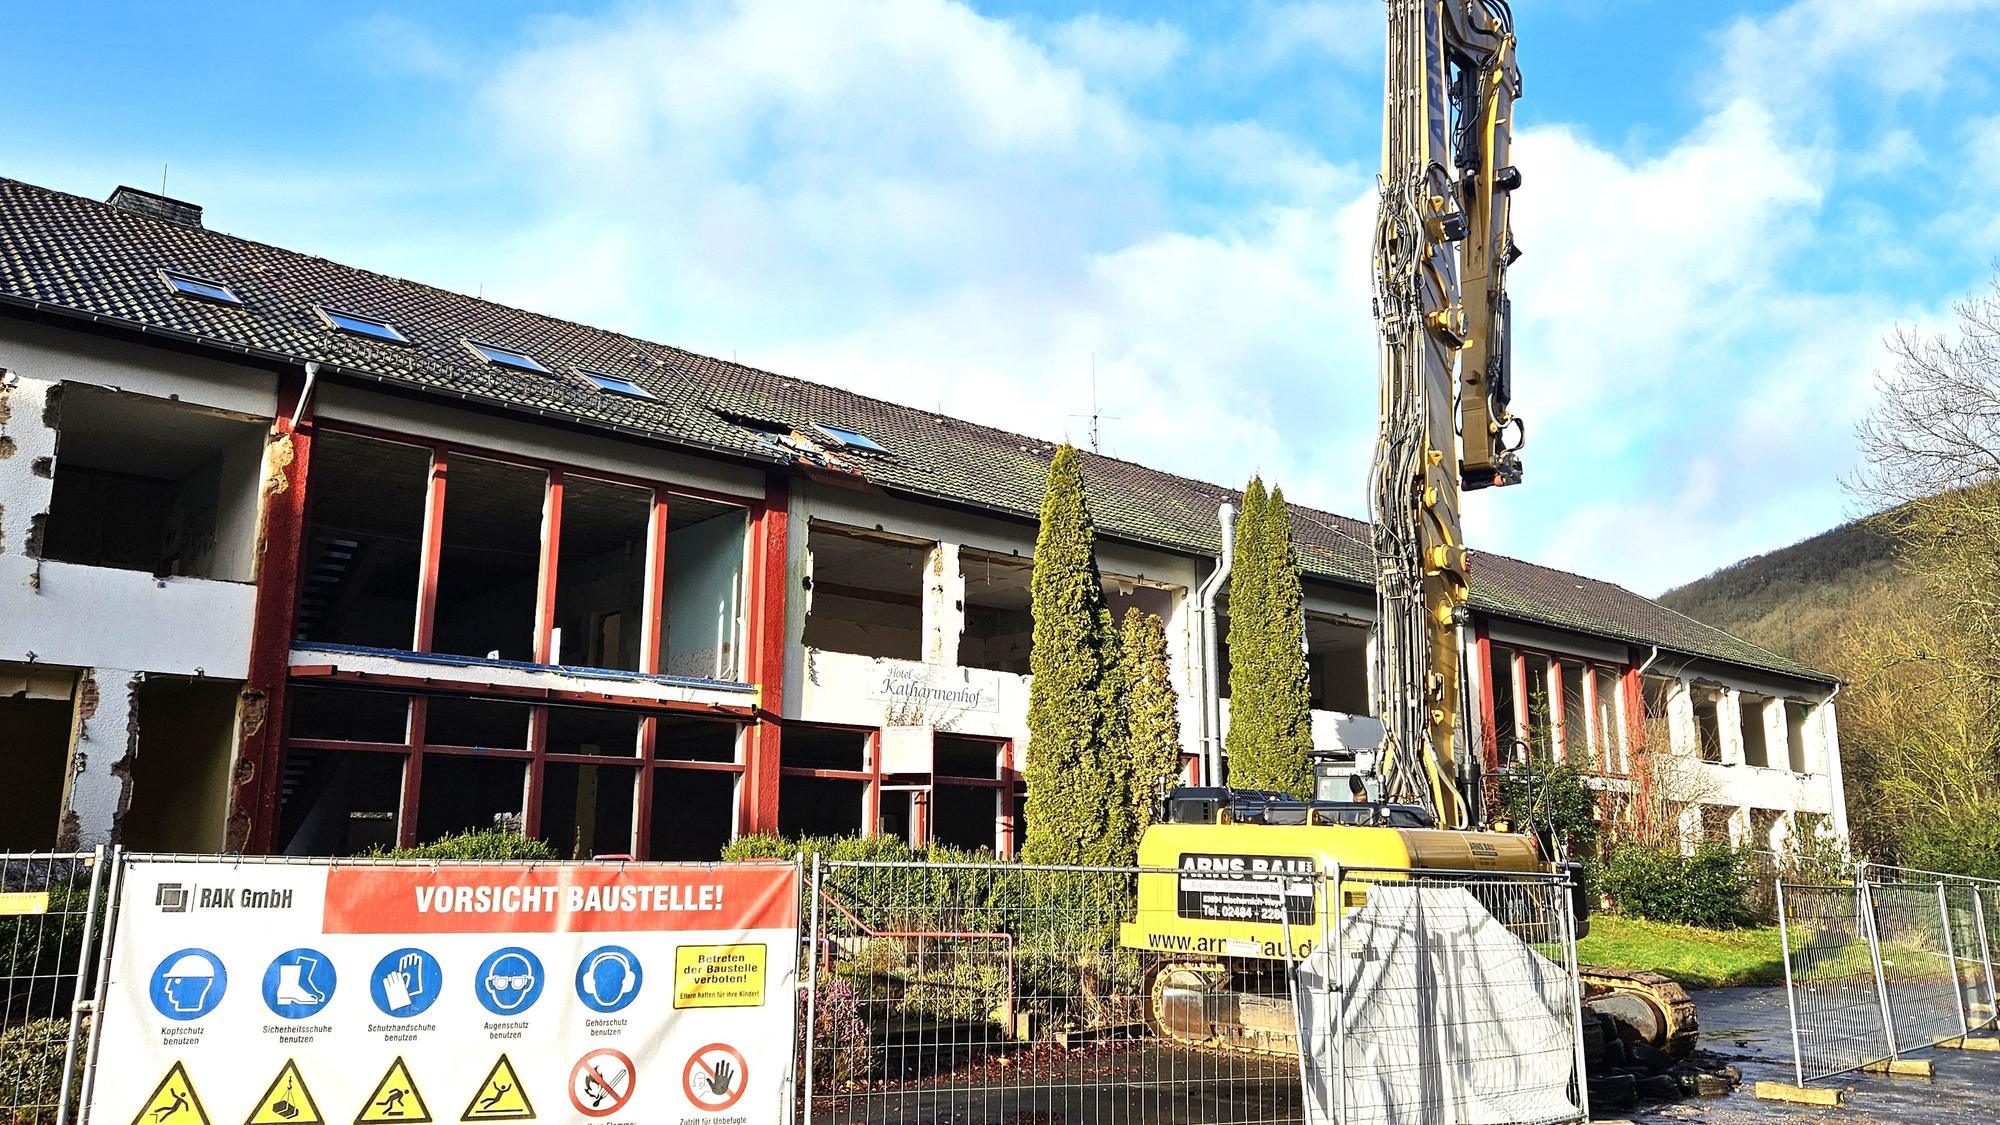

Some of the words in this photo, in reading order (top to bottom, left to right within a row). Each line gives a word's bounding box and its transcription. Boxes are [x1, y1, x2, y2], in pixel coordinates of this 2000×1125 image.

[887, 666, 912, 679] Hotel
[1181, 857, 1245, 879] ARNS
[1252, 859, 1306, 881] BAU
[199, 887, 234, 908] RAK
[241, 887, 293, 909] GmbH
[415, 885, 558, 913] VORSICHT
[566, 885, 723, 912] BAUSTELLE!
[1203, 905, 1220, 917] Tel.
[1222, 906, 1252, 919] 02484
[698, 954, 745, 963] Betreten
[684, 966, 702, 974] der
[706, 964, 758, 974] Baustelle
[694, 974, 747, 984] verboten!
[484, 1021, 529, 1030] Augenschutz
[585, 1018, 628, 1027] Gehörschutz
[161, 1026, 205, 1036] Kopfschutz
[262, 1025, 332, 1034] Sicherheitsschuhe
[368, 1023, 436, 1033] Schutzhandschuhe
[590, 1027, 622, 1036] benutzen
[279, 1034, 314, 1044] benutzen
[384, 1033, 418, 1042] benutzen
[489, 1030, 522, 1039] benutzen
[163, 1036, 199, 1045] benutzen
[713, 1117, 747, 1125] Unbefugte
